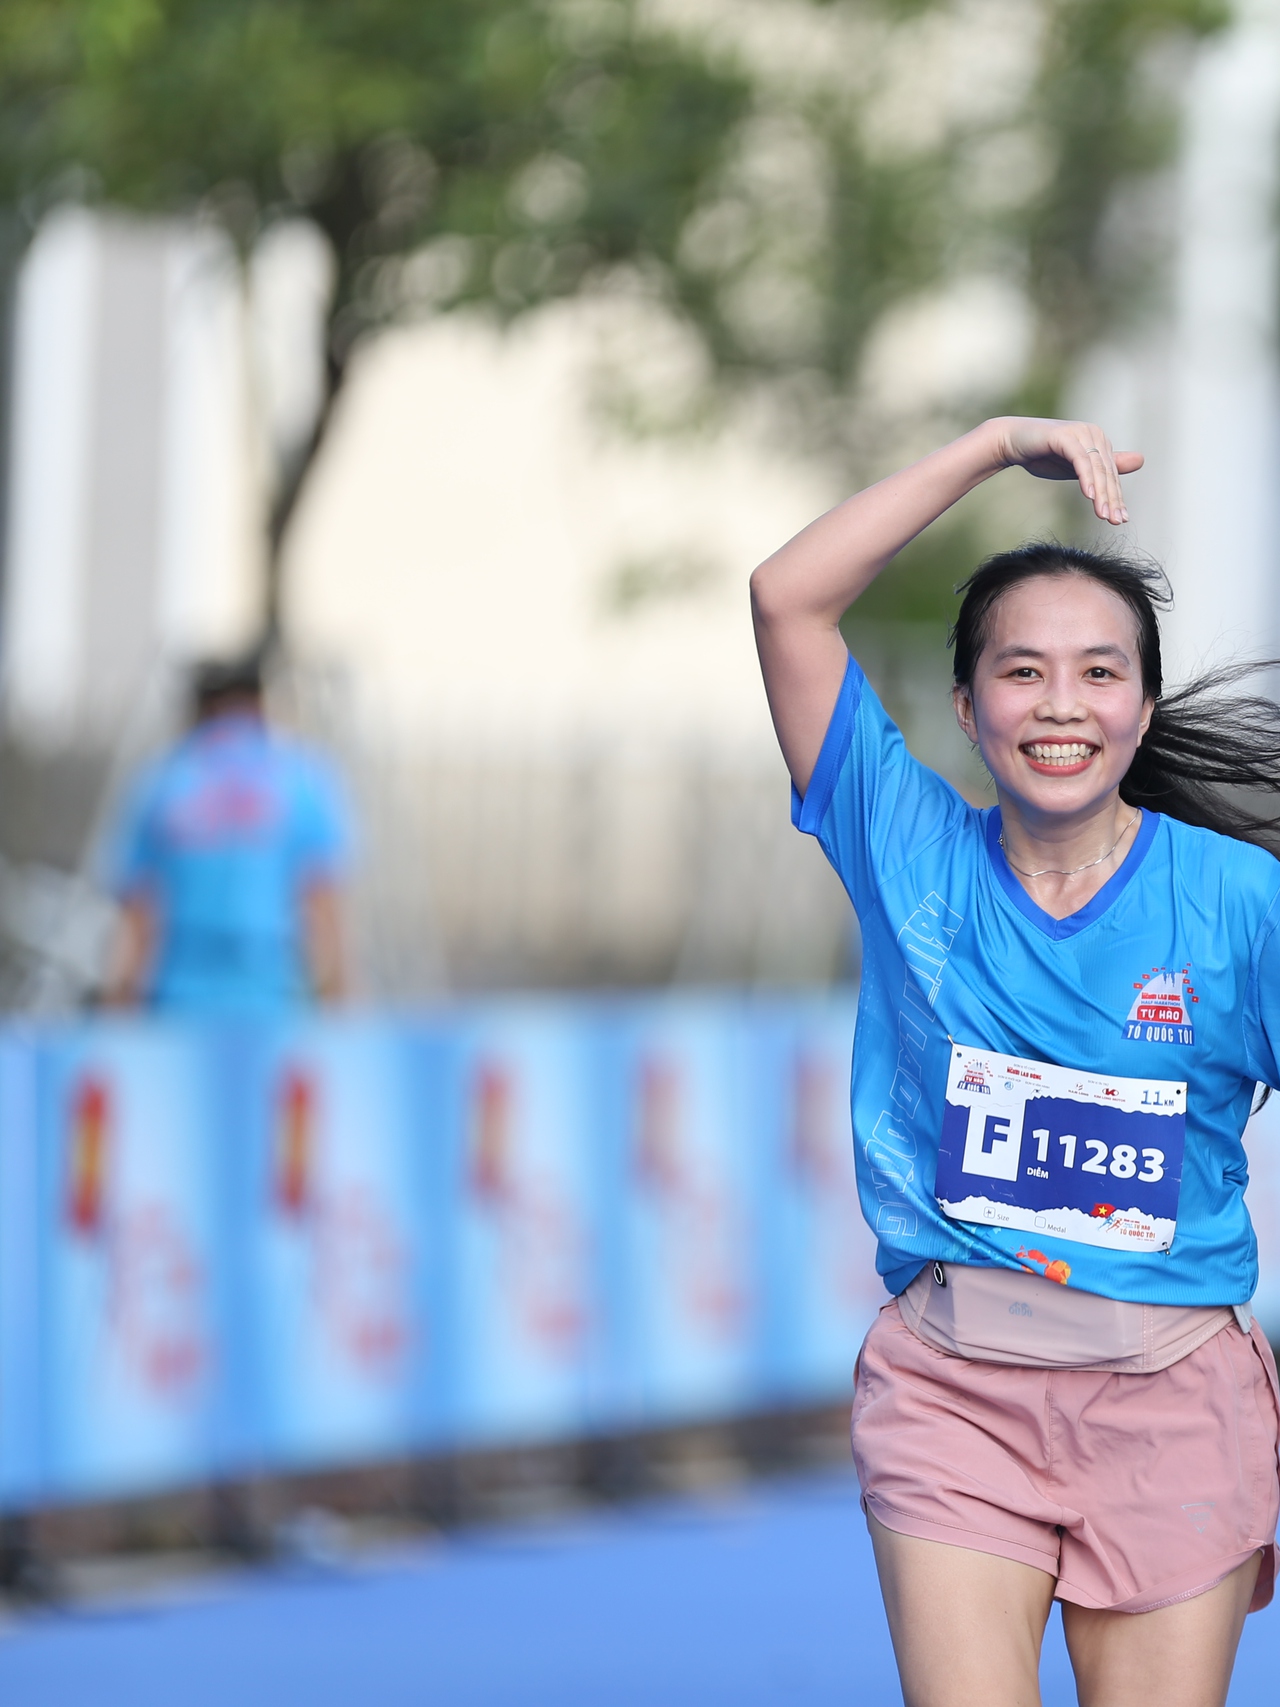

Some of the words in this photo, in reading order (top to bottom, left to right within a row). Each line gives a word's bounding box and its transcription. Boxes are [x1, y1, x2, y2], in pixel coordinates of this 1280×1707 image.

[1140, 1008, 1156, 1021] TỰ
[1159, 1007, 1180, 1020] HÀO
[981, 1114, 1011, 1155] F
[1032, 1128, 1166, 1183] 11283
[997, 1214, 1010, 1222] Size
[1047, 1223, 1067, 1233] Medal
